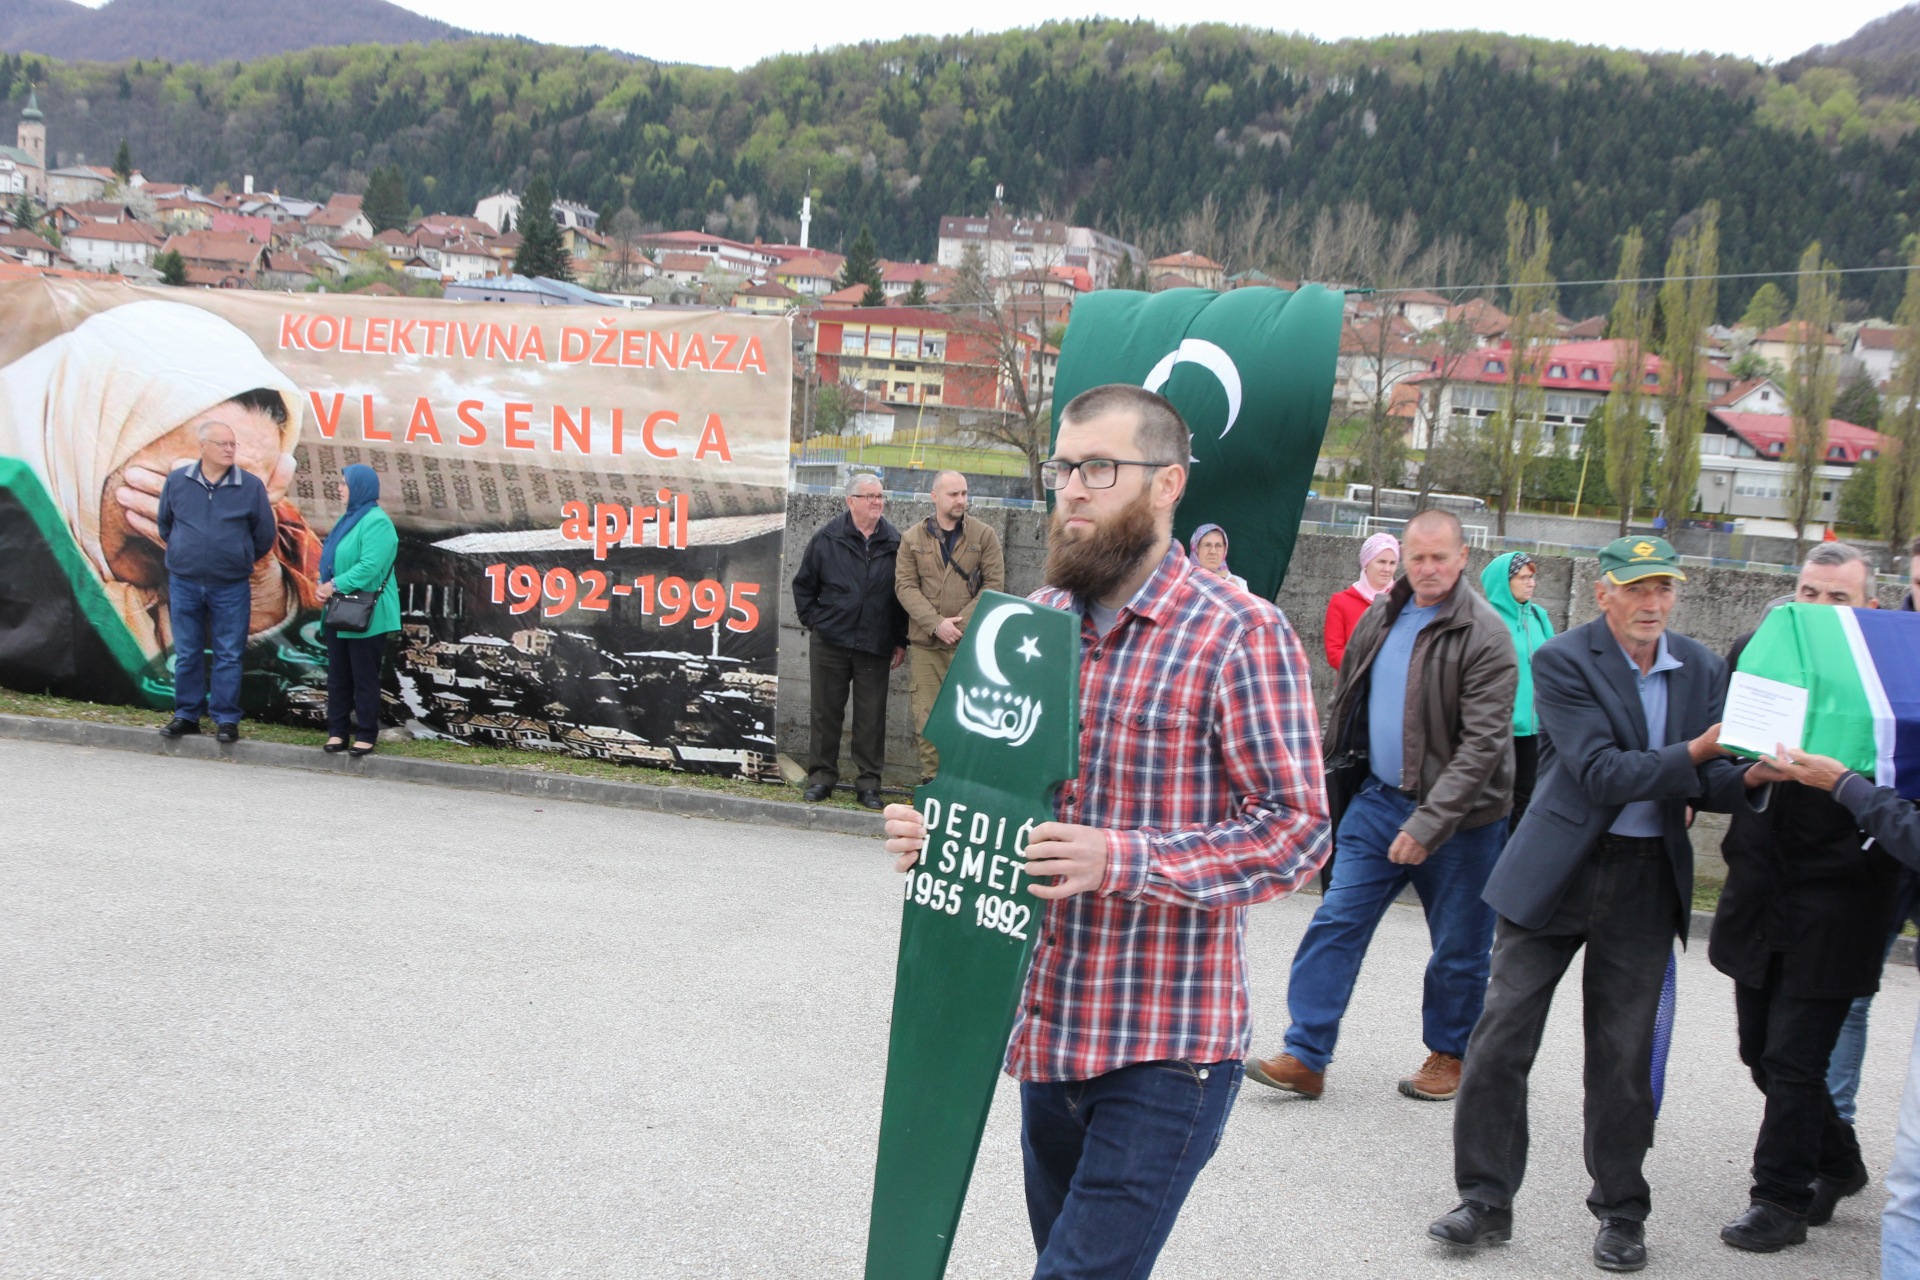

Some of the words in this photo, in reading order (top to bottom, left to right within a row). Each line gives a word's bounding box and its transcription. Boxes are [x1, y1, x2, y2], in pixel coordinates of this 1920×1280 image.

[278, 313, 547, 363] KOLEKTIVNA
[558, 317, 768, 375] DŽENAZA
[308, 391, 733, 463] VLASENICA
[560, 486, 690, 561] april
[484, 562, 761, 633] 1992-1995
[919, 834, 1026, 895] ISMET
[904, 868, 964, 916] 1955
[974, 893, 1031, 941] 1992
